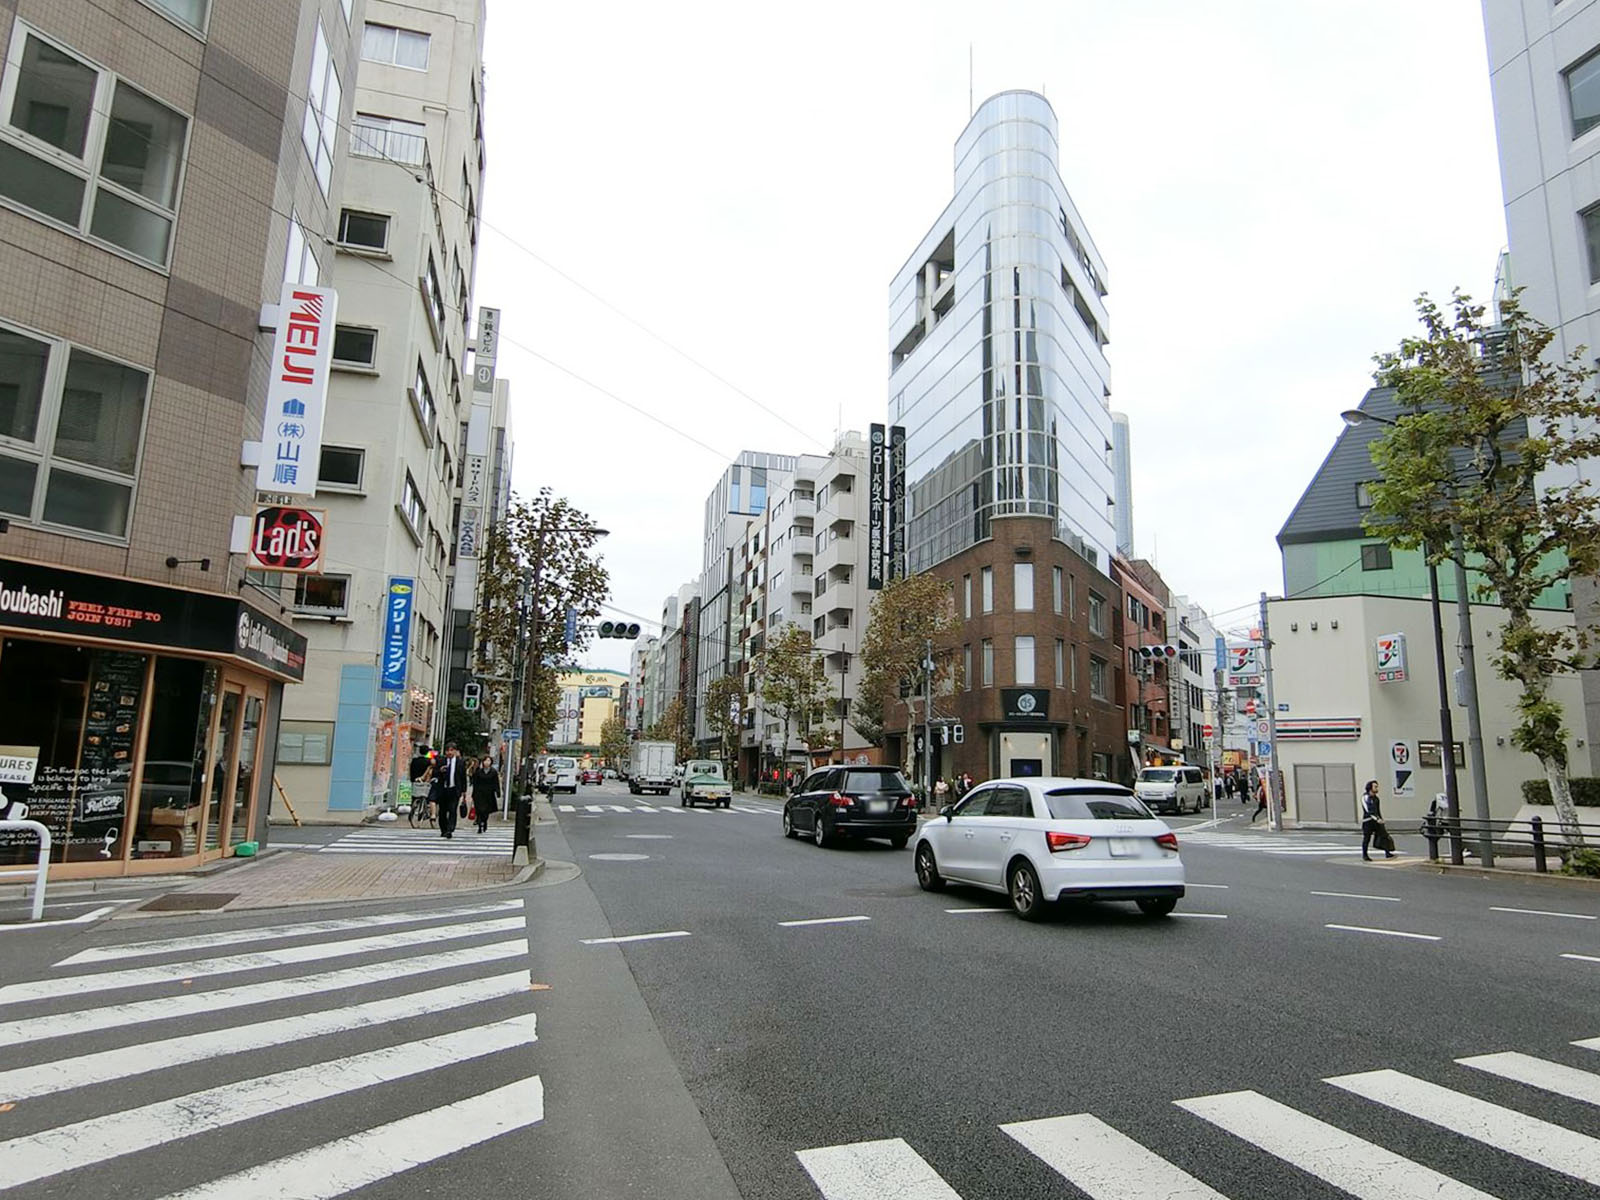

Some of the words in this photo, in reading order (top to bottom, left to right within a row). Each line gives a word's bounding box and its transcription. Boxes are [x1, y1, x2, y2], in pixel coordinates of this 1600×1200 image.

[282, 291, 324, 385] MEIJI
[256, 517, 317, 558] Lad's
[67, 611, 101, 623] JOIN
[105, 617, 132, 628] US!!
[68, 601, 105, 614] FEEL
[107, 606, 142, 619] FREE
[145, 612, 161, 622] TO
[388, 598, 407, 673] クリーニング
[43, 766, 58, 775] In
